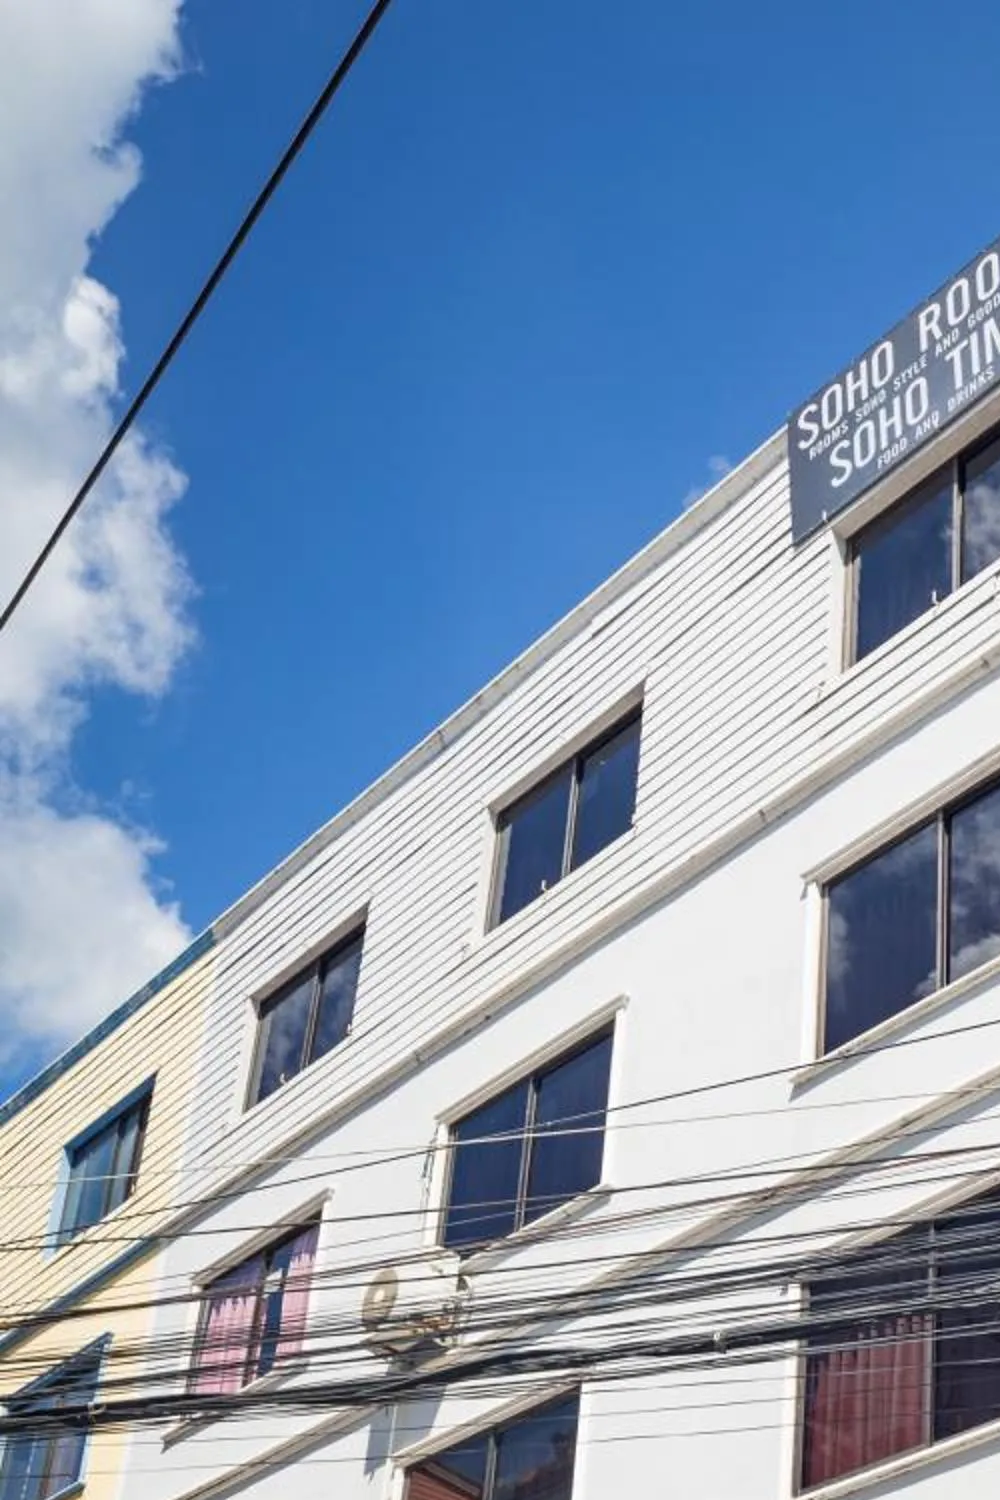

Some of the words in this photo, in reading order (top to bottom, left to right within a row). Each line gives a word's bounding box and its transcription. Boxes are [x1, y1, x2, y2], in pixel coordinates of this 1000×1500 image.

[797, 341, 895, 450] SOHO
[809, 423, 849, 461] ROOMS
[855, 391, 886, 424] SOHO
[893, 356, 928, 389] STYLE
[935, 331, 960, 359] AND
[829, 377, 929, 488] SOHO
